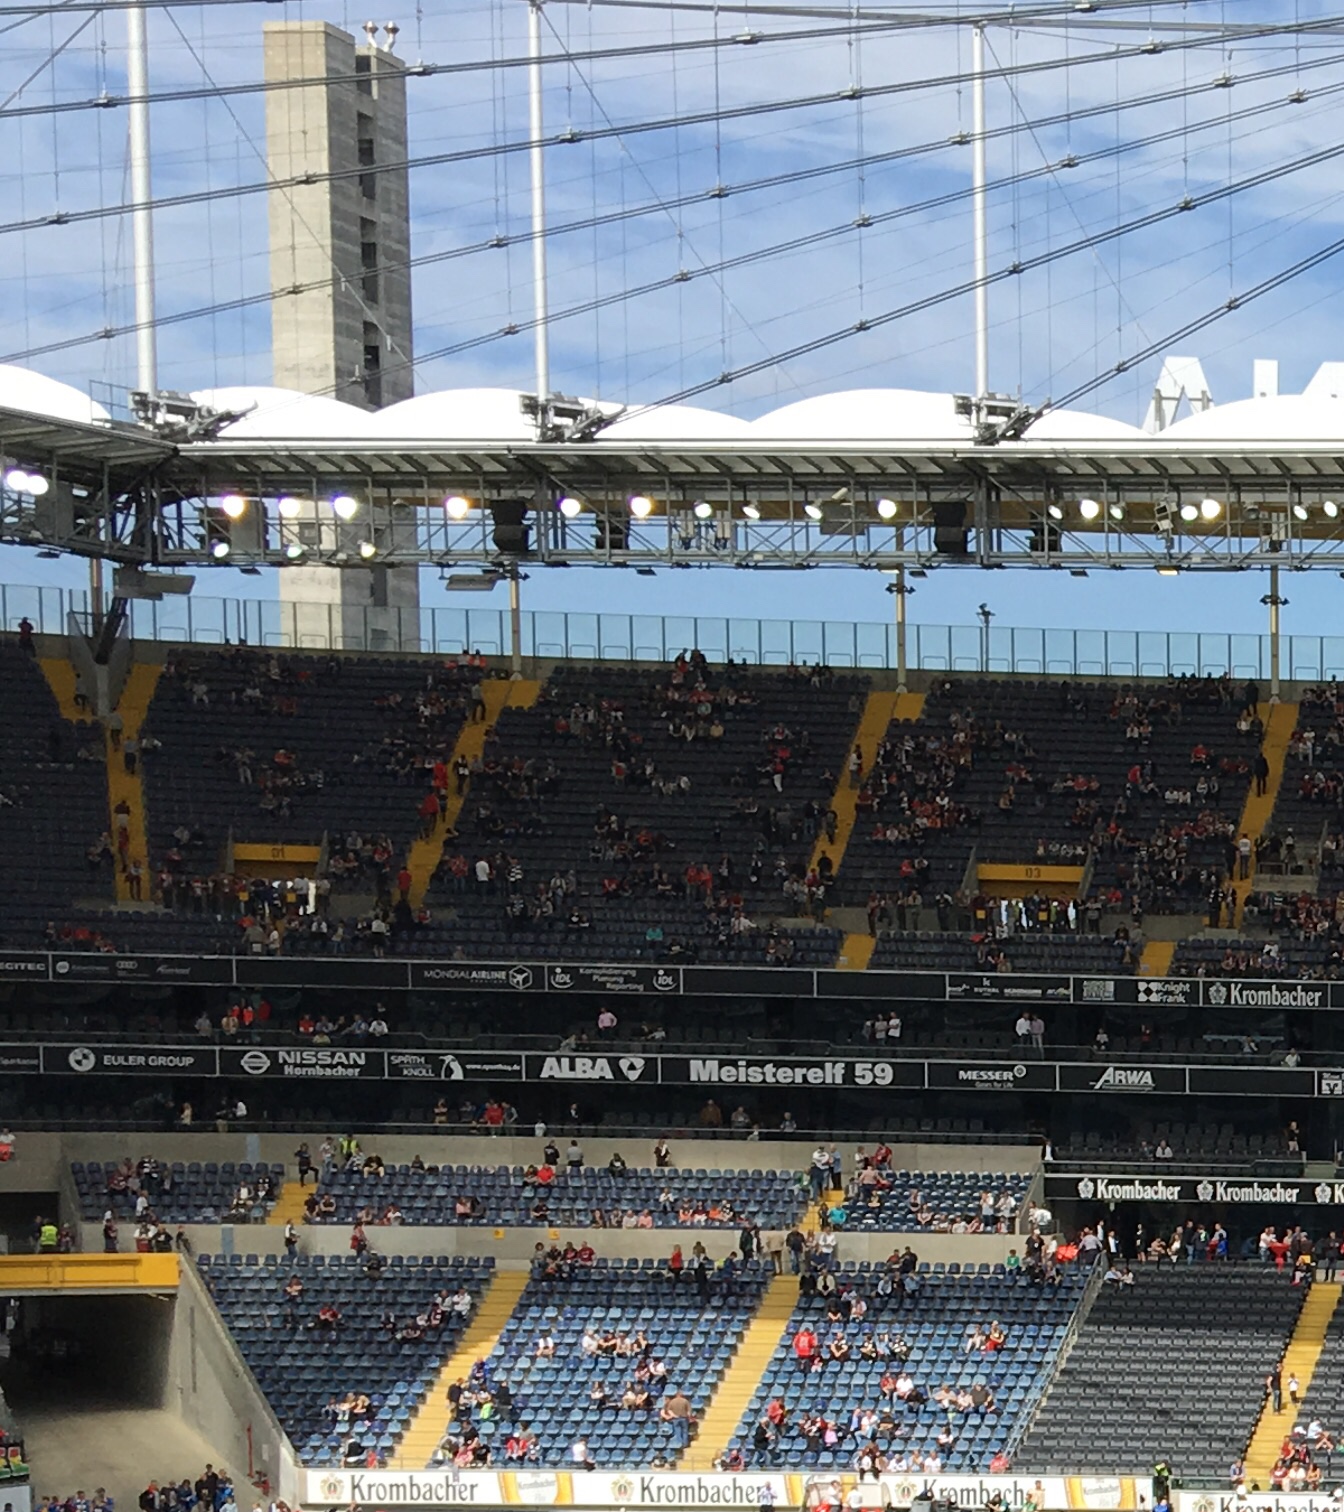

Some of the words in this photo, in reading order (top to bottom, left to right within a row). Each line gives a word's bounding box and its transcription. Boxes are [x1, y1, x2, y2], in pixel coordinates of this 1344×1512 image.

[1230, 983, 1323, 1008] Krombacher
[103, 1054, 146, 1067] EULER
[148, 1055, 196, 1068] GROUP
[279, 1051, 366, 1066] NISSAN
[539, 1056, 615, 1080] ALBA
[284, 1065, 361, 1077] Hornbacher
[690, 1059, 847, 1084] Meisterelf
[854, 1062, 895, 1085] 59
[959, 1070, 1015, 1081] MESSER
[1094, 1066, 1153, 1090] ARWA
[1097, 1180, 1181, 1201] Krombacher
[1216, 1182, 1300, 1203] Krombacher
[350, 1475, 479, 1502] Krombacher
